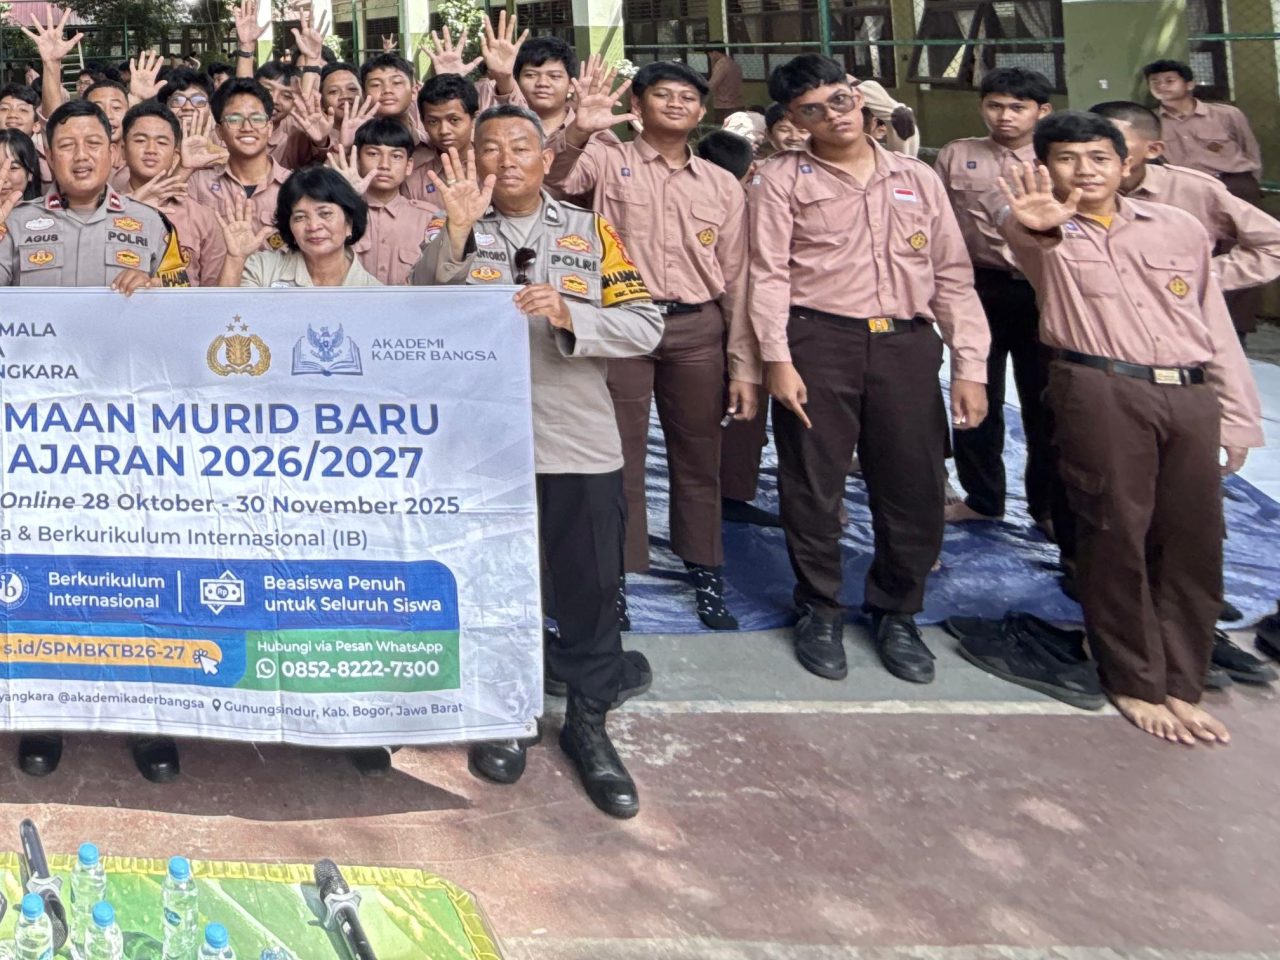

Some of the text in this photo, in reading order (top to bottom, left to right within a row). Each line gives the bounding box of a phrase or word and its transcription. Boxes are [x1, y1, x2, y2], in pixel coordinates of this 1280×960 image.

[25, 234, 59, 244] AGUS
[108, 231, 148, 247] POLRI
[551, 254, 597, 271] POLRI
[371, 338, 445, 349] AKADEMI
[371, 350, 497, 361] KADER BANGSA
[152, 403, 299, 434] MURID
[315, 403, 439, 435] BARU
[7, 444, 184, 476] AJARAN
[199, 440, 423, 481] 2026/2027
[0, 491, 75, 509] Online
[82, 493, 109, 510] 28
[117, 493, 214, 513] Oktober
[236, 495, 265, 513] 30
[273, 496, 398, 514] November
[405, 497, 459, 515] 2025
[19, 526, 31, 541] &
[38, 526, 180, 544] Berkurikulum
[188, 529, 325, 546] Internasional
[333, 529, 368, 550] (IB)
[49, 571, 165, 588] Berkurikulum
[264, 575, 405, 591] Beasiswa Penuh
[49, 592, 159, 608] Internasional
[217, 587, 227, 597] Rp
[265, 597, 441, 613] untuk Seluruh Siswa
[3, 640, 185, 659] s.id/SPMBKTB26-27
[257, 641, 443, 655] Hubungi via Pesan WhatsApp
[282, 660, 439, 677] 0852-8222-7300
[58, 692, 204, 709] @akademikaderbangsa
[224, 701, 319, 719] Gunungsindur,
[322, 706, 350, 717] Kab.
[353, 705, 394, 717] Bogor,
[396, 705, 428, 716] Jawa
[431, 702, 464, 714] Barat
